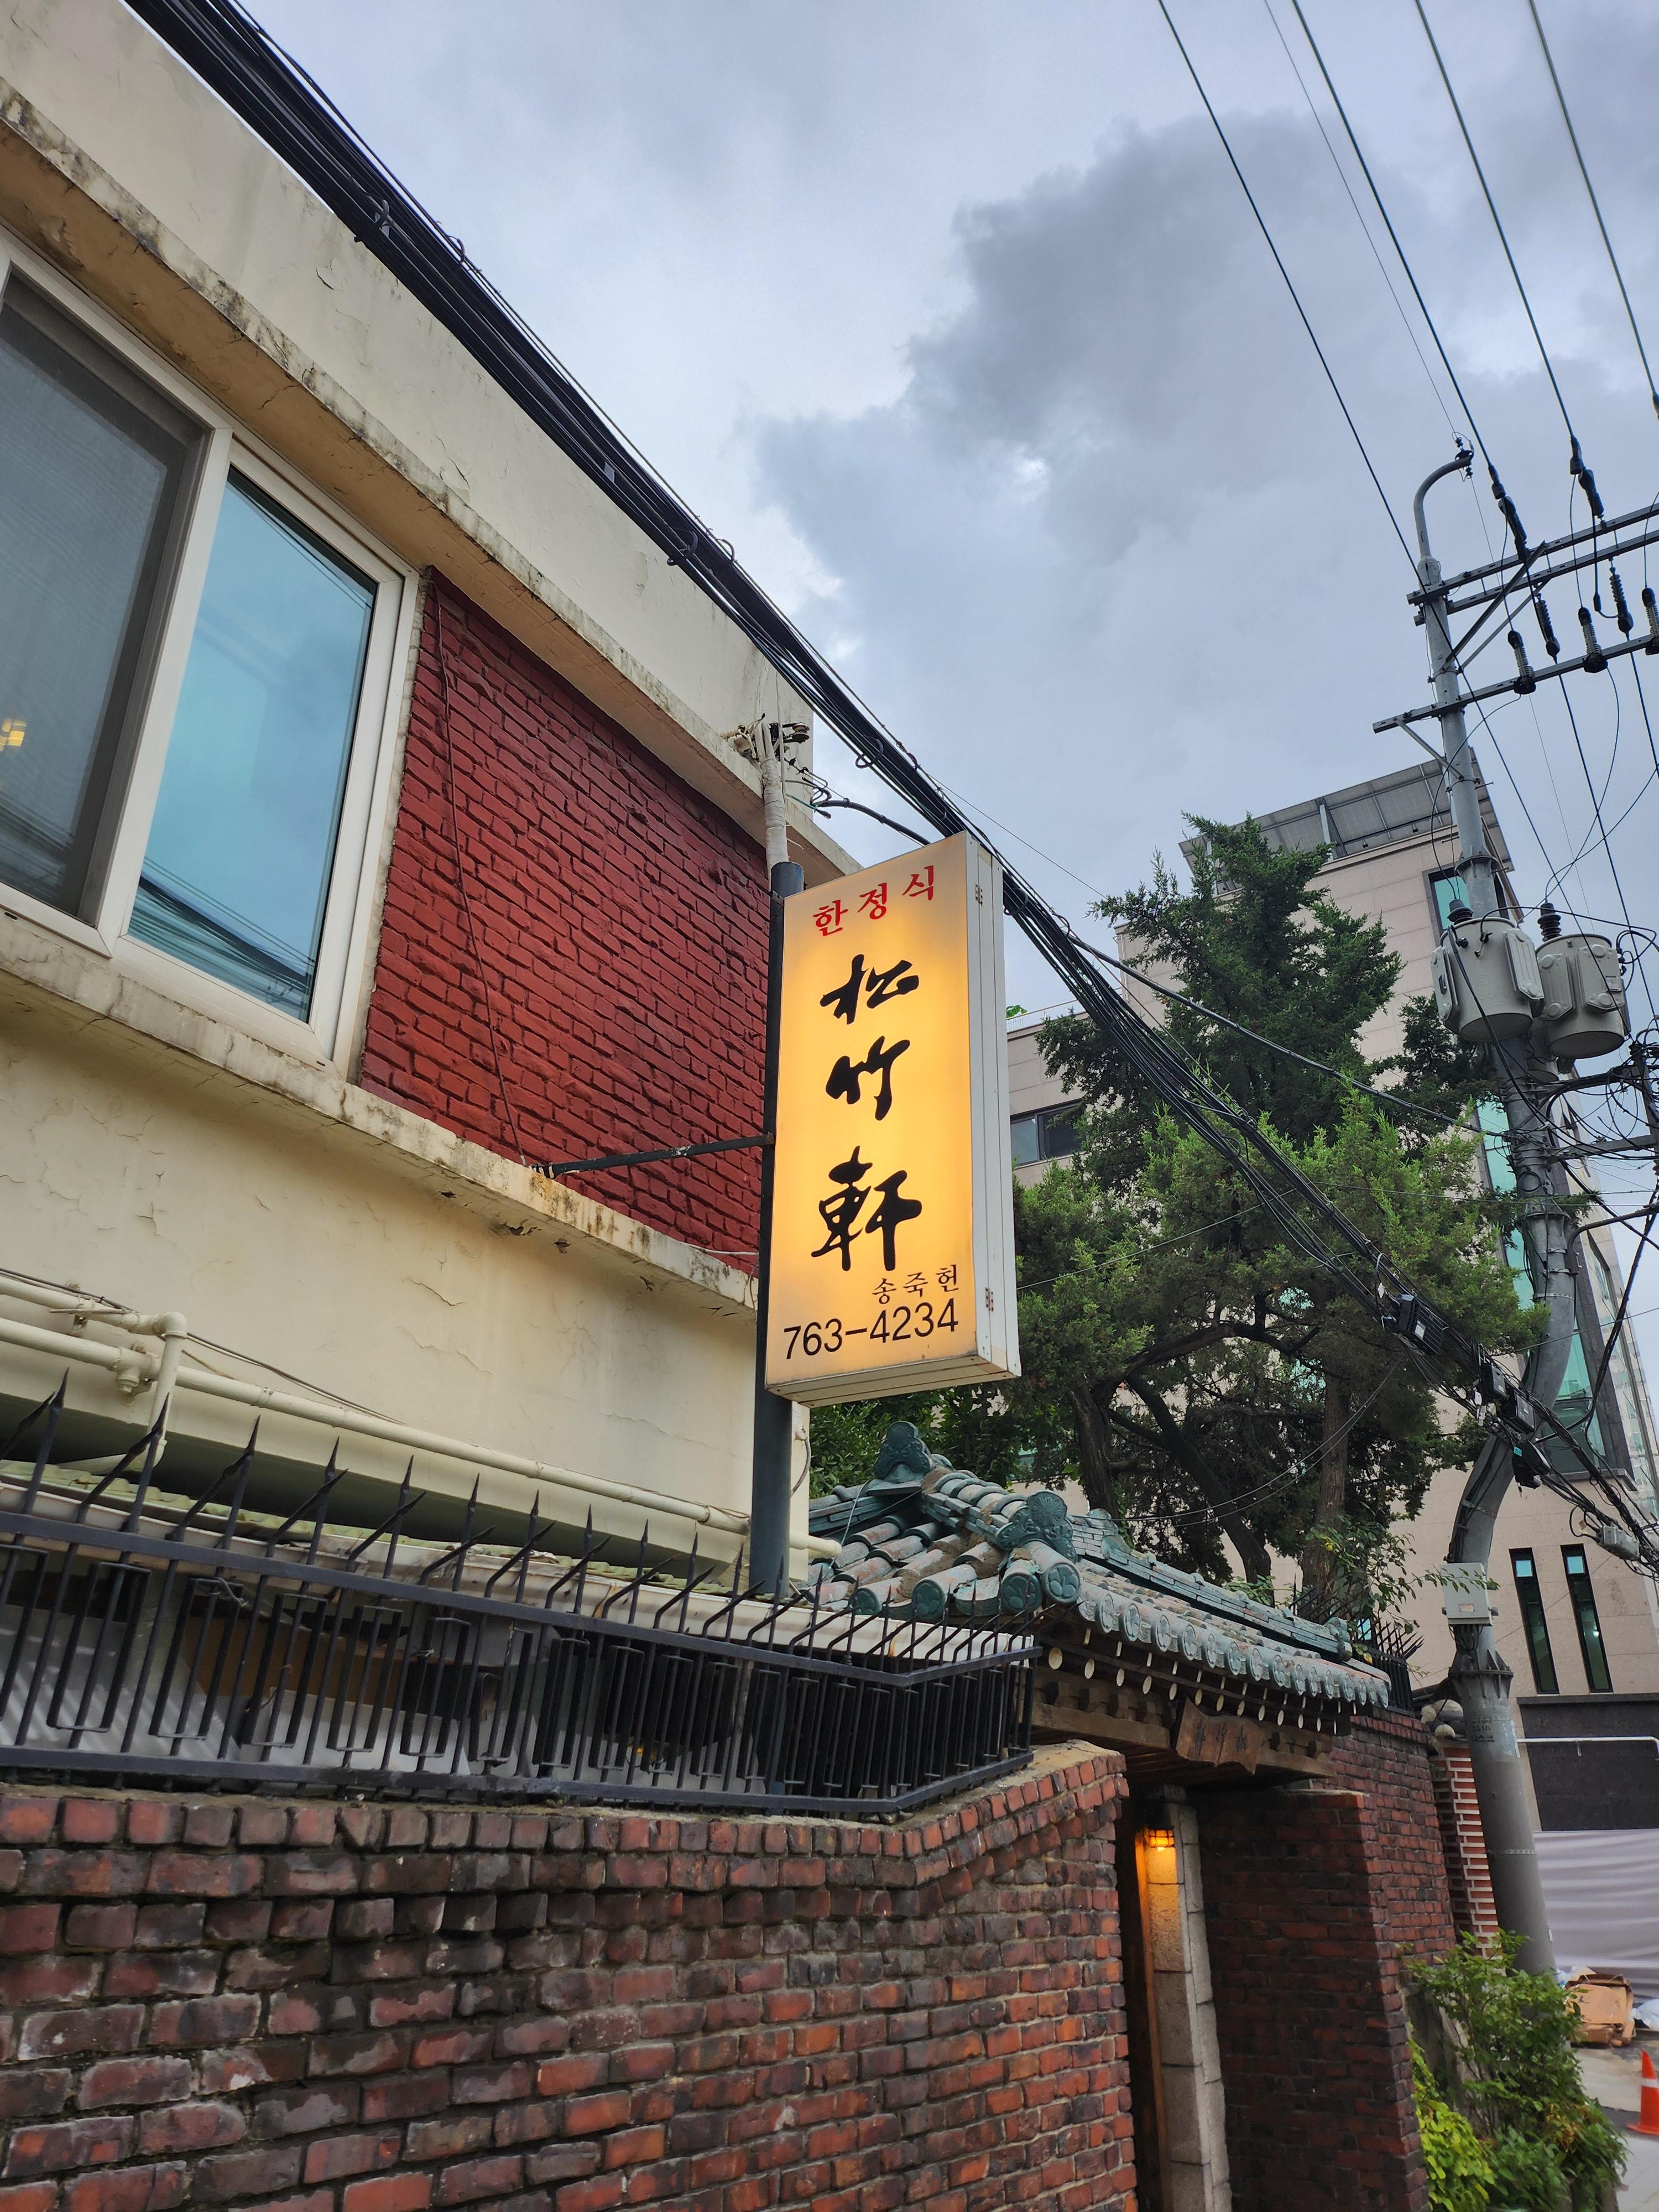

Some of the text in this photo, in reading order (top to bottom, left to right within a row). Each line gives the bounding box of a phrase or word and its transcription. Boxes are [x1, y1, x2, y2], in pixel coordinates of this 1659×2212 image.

[812, 865, 935, 937] 한정식
[811, 954, 922, 1272] 松竹軒
[872, 1264, 959, 1305] 송죽헌
[783, 1297, 959, 1360] 763-4234
